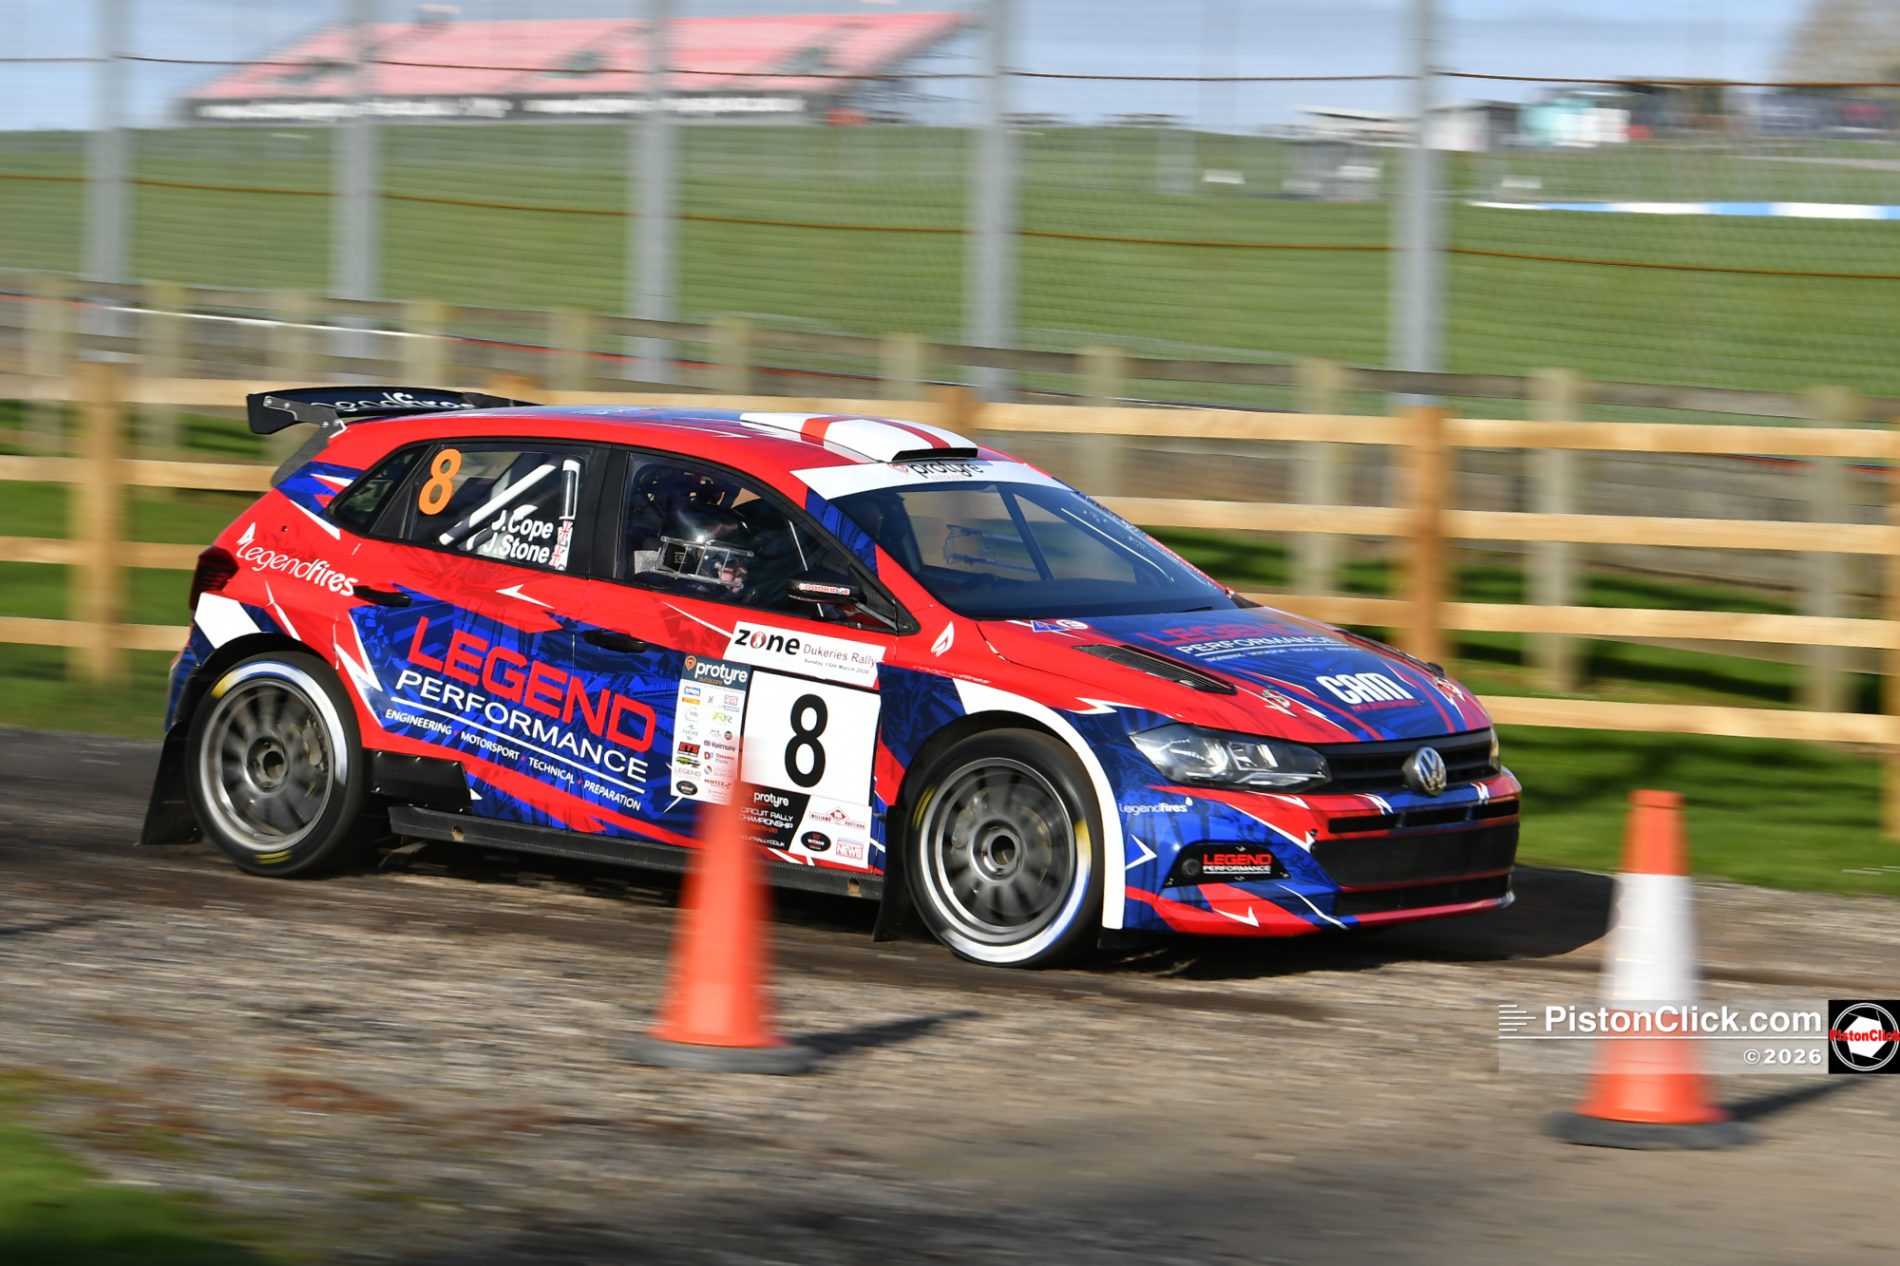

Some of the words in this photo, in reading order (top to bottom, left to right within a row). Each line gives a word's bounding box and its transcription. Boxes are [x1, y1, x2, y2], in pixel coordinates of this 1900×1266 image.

[418, 448, 462, 516] 8
[910, 462, 984, 479] protyre
[491, 510, 554, 541] J.Cope
[483, 533, 550, 564] J.Stone
[734, 628, 800, 656] zone
[803, 643, 848, 661] Dukeries
[851, 652, 878, 668] Rally
[1175, 636, 1340, 654] PERFORMANCE
[407, 616, 657, 752] LEGEND
[694, 662, 748, 685] protyre
[395, 669, 648, 783] PERFORMANCE
[785, 693, 828, 788] 8
[385, 709, 452, 735] ENGINEERING
[460, 731, 520, 761] MOTORSPORT
[528, 757, 575, 784] TECHNICAL
[583, 780, 641, 811] PREPARATION
[754, 792, 789, 807] protyre
[1119, 802, 1188, 816] legendfires
[740, 813, 793, 829] CHAMPIONSHIP
[741, 806, 768, 817] CIRCUIT
[770, 811, 793, 822] RALLY
[1203, 853, 1272, 865] LEGEND
[1203, 865, 1272, 873] PERFORMANCE
